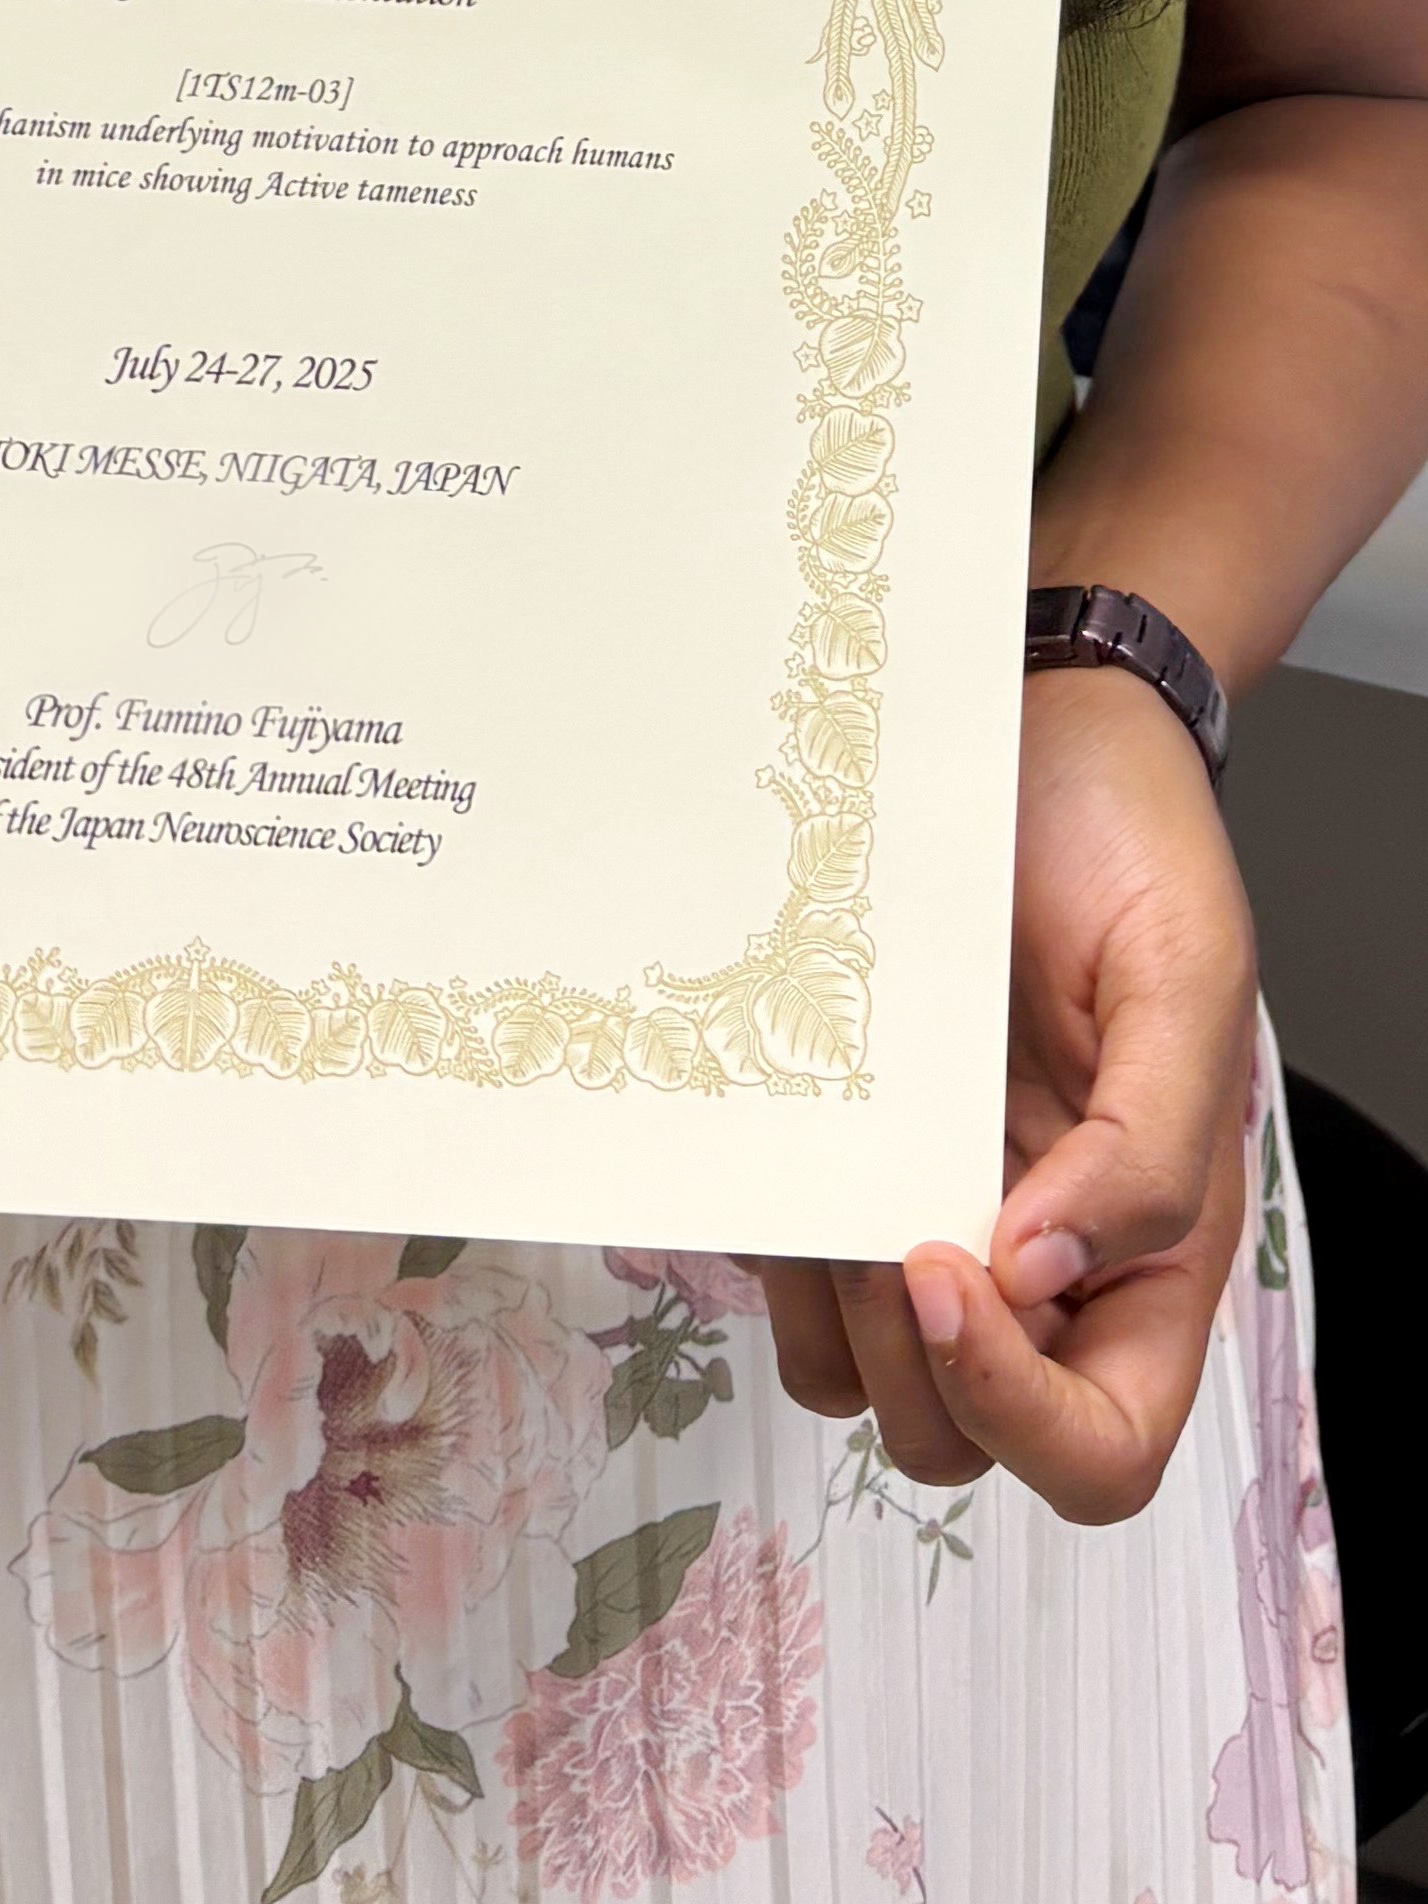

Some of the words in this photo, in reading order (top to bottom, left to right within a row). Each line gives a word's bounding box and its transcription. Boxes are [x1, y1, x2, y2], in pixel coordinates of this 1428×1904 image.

[176, 69, 354, 111] [1TS12m-03]
[101, 114, 243, 156] underlying
[253, 125, 398, 154] motivation
[408, 135, 434, 156] to
[442, 136, 564, 169] approach
[572, 137, 675, 170] humans
[37, 159, 63, 185] in
[73, 162, 132, 188] mice
[139, 162, 252, 204] showing
[255, 172, 349, 199] Active
[358, 180, 477, 206] tameness
[105, 344, 180, 393] July
[184, 351, 283, 393] 24-27,
[293, 356, 378, 391] 2025
[75, 445, 207, 485] MESSE,
[216, 452, 381, 495] NIIGATA,
[386, 461, 521, 497] JAPAN
[26, 692, 109, 742] Prof.
[116, 699, 242, 736] Fumino
[252, 706, 403, 754] Fujiyama
[80, 749, 121, 795] of
[118, 751, 163, 786] the
[168, 755, 237, 790] 48th
[234, 762, 361, 796] Annual
[355, 768, 476, 814] Meeting
[7, 800, 52, 835] the
[52, 807, 144, 850] Japan
[149, 811, 336, 850] Neuroscience
[338, 822, 442, 867] Society
